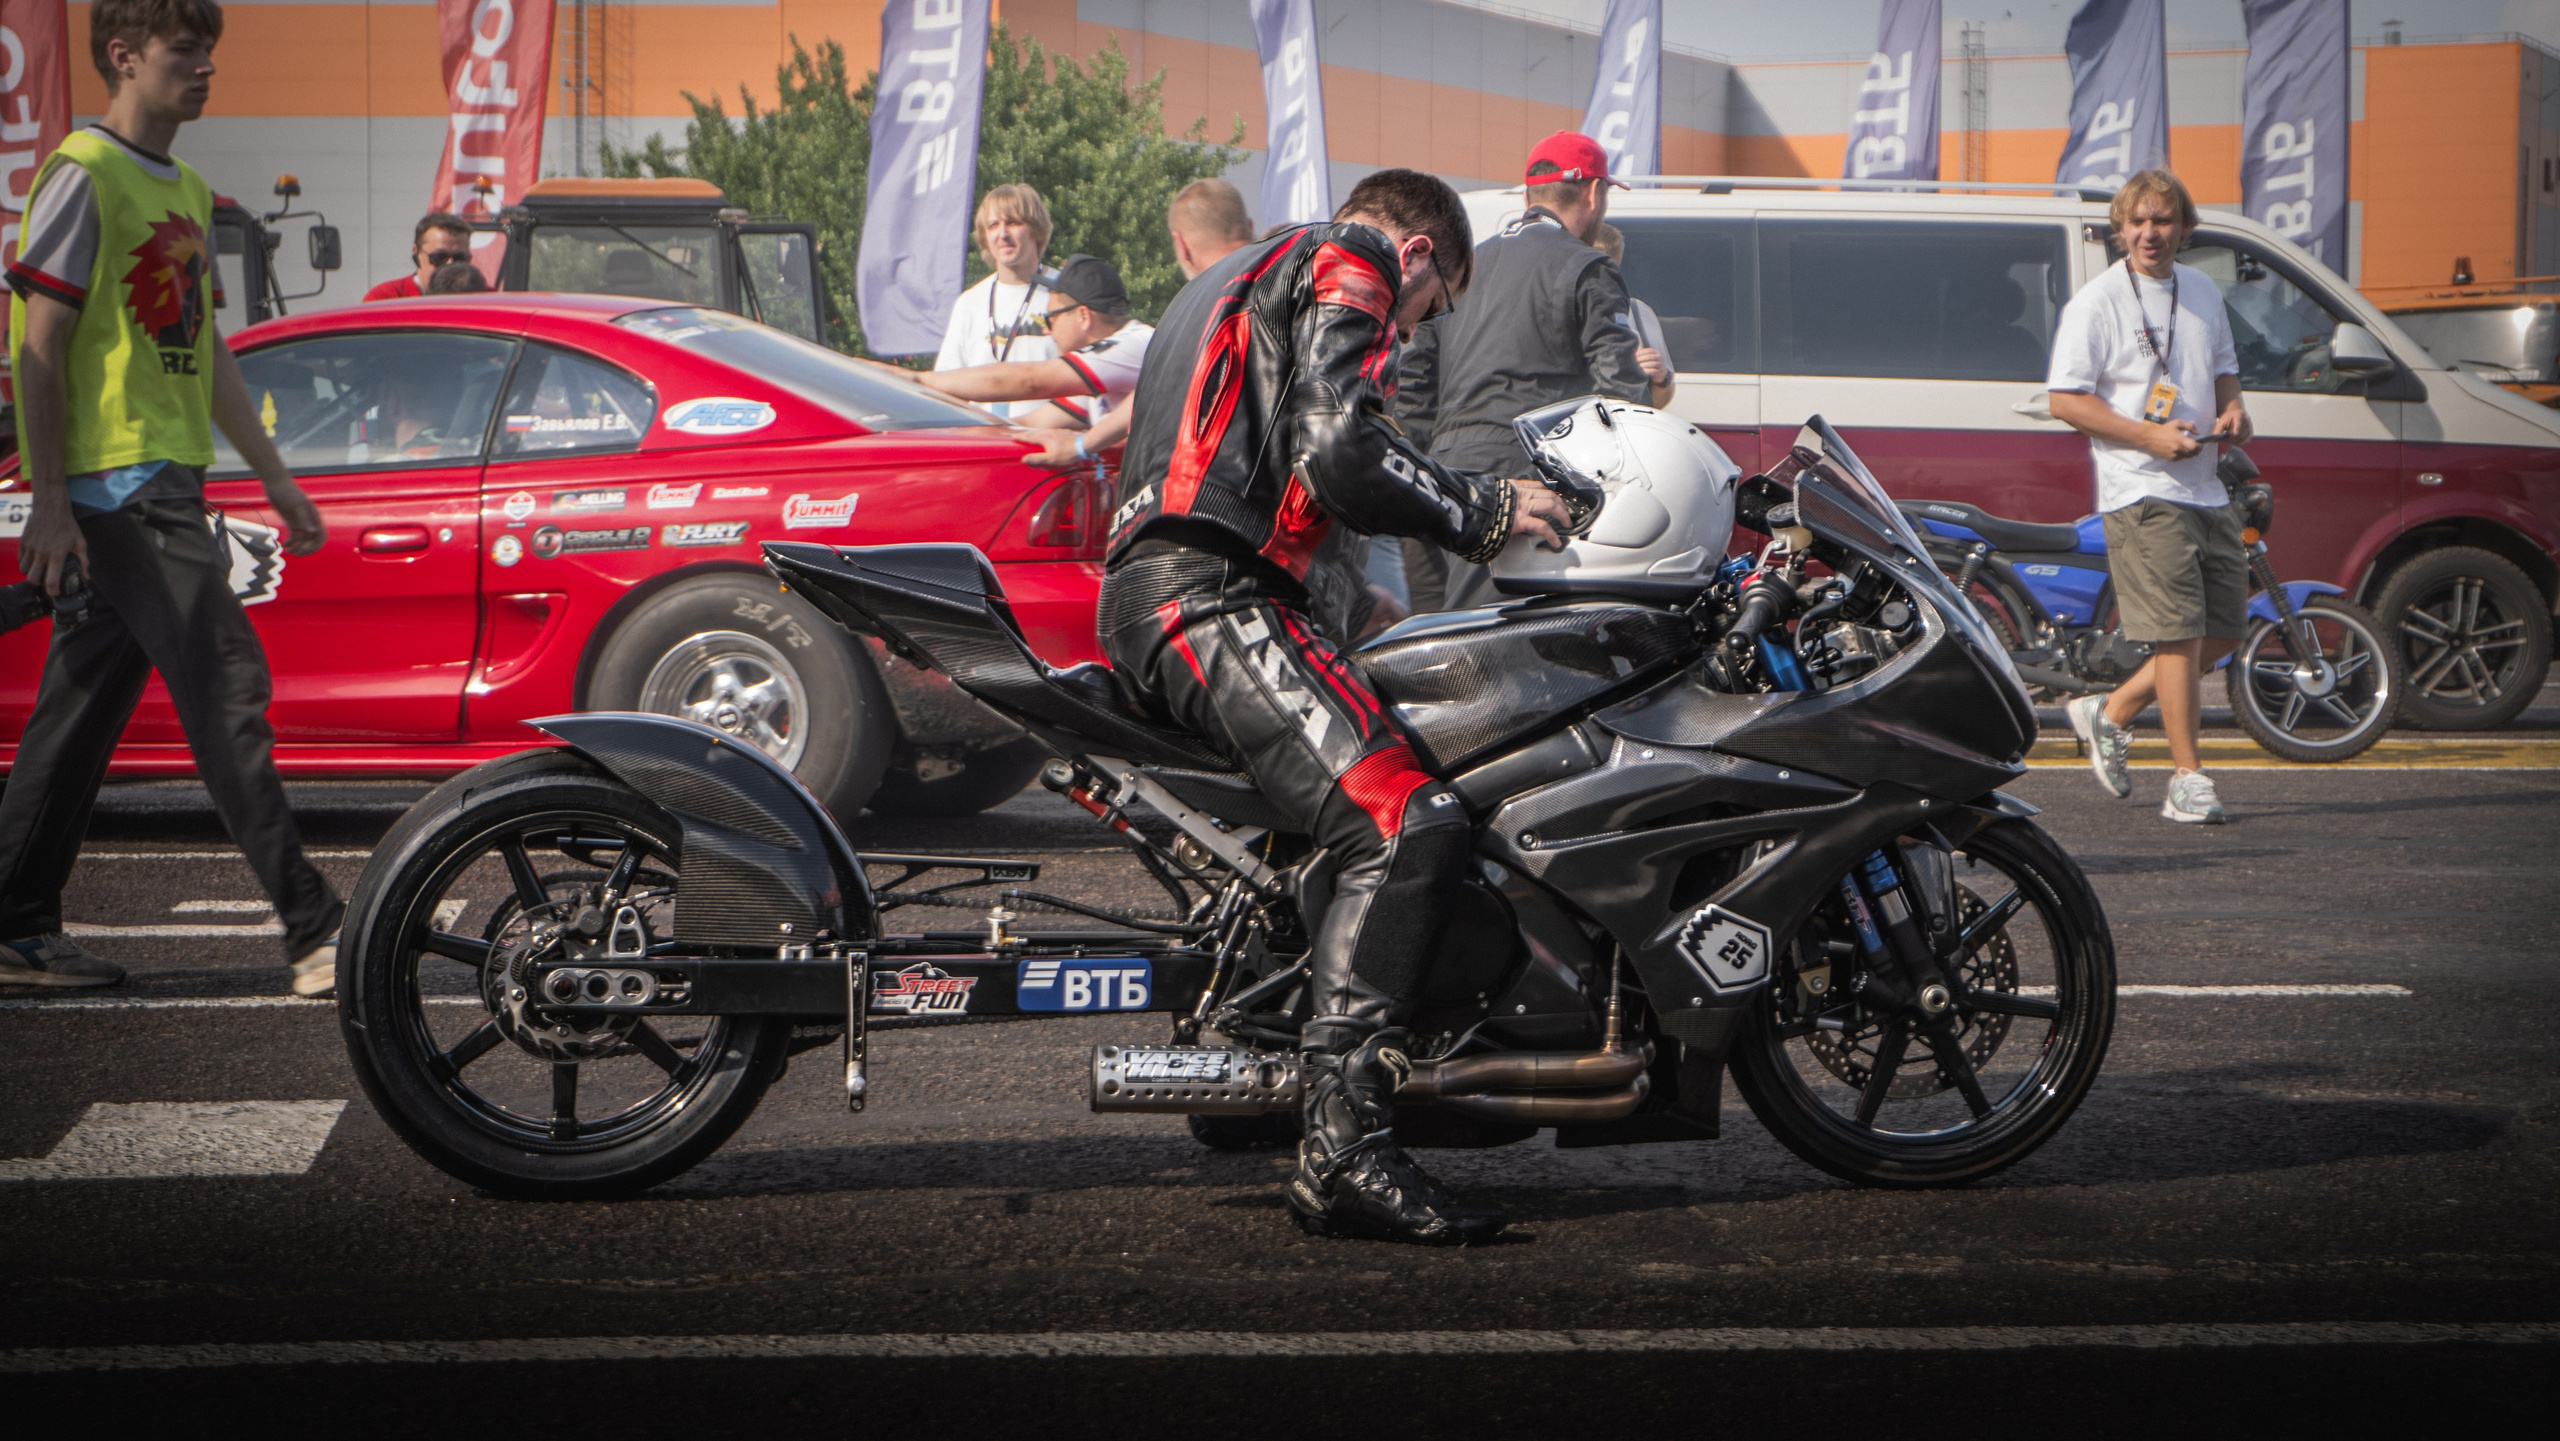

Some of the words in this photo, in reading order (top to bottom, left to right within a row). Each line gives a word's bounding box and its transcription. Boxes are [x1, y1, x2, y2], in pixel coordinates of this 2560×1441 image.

[1928, 504, 1969, 519] RACER
[733, 596, 813, 648] M/T
[1717, 938, 1754, 970] 25
[898, 972, 975, 993] STREET
[1064, 968, 1149, 1009] ВТБ
[911, 991, 965, 1010] FUN
[1129, 1052, 1227, 1065] VANCE
[1126, 1063, 1222, 1078] HINES
